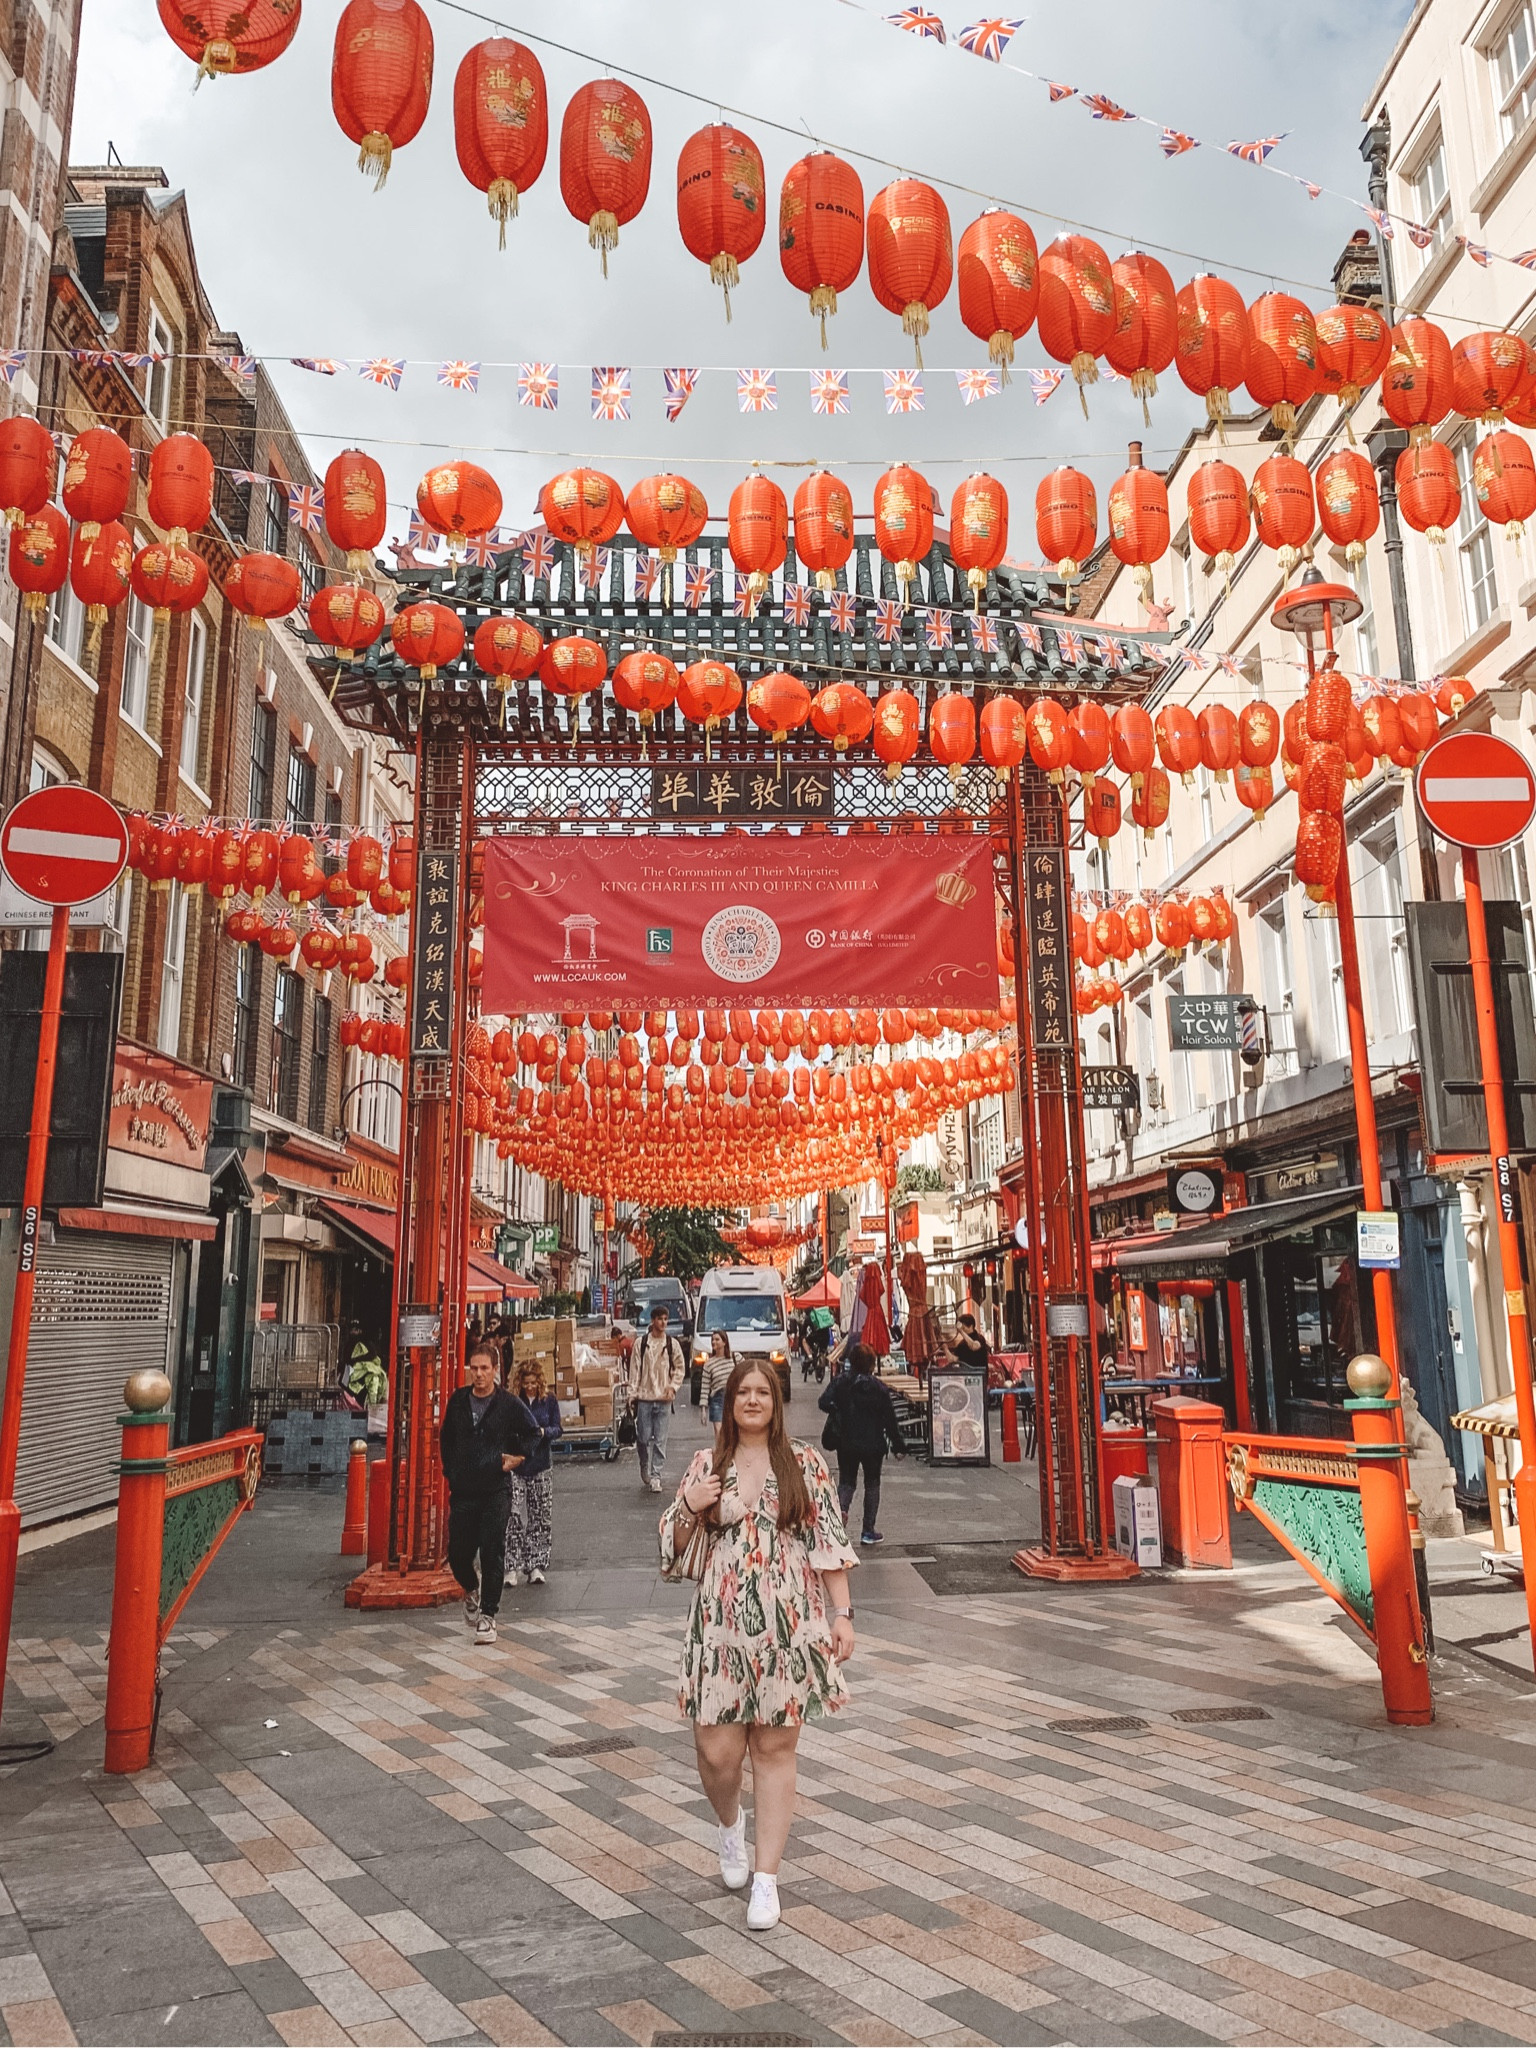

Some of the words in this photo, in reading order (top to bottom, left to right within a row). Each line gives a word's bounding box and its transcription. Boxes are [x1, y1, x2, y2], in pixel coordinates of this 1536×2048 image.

[641, 866, 664, 877] The
[667, 866, 732, 877] Coronation
[736, 865, 748, 877] of
[752, 866, 785, 877] Their
[788, 865, 840, 878] Majesties
[601, 881, 638, 892] KING
[641, 881, 707, 892] CHARLES
[711, 881, 726, 892] III
[730, 881, 760, 892] AND
[763, 880, 813, 895] QUEEN
[816, 880, 879, 891] CAMILLA
[5, 911, 37, 919] CHINESE
[710, 914, 727, 931] KING
[727, 908, 764, 921] CHARLES
[705, 936, 738, 979] CORONATION
[533, 973, 627, 983] WWW.LCCAUK.COM
[1179, 1001, 1229, 1016] 大中華
[1181, 1019, 1229, 1034] TCW
[1181, 1035, 1201, 1045] Hair
[1204, 1034, 1232, 1045] Salon
[1498, 1157, 1509, 1186] S8
[369, 1166, 391, 1200] FUNG
[1502, 1193, 1513, 1222] S7
[24, 1207, 36, 1235] S6
[21, 1243, 33, 1272] S5
